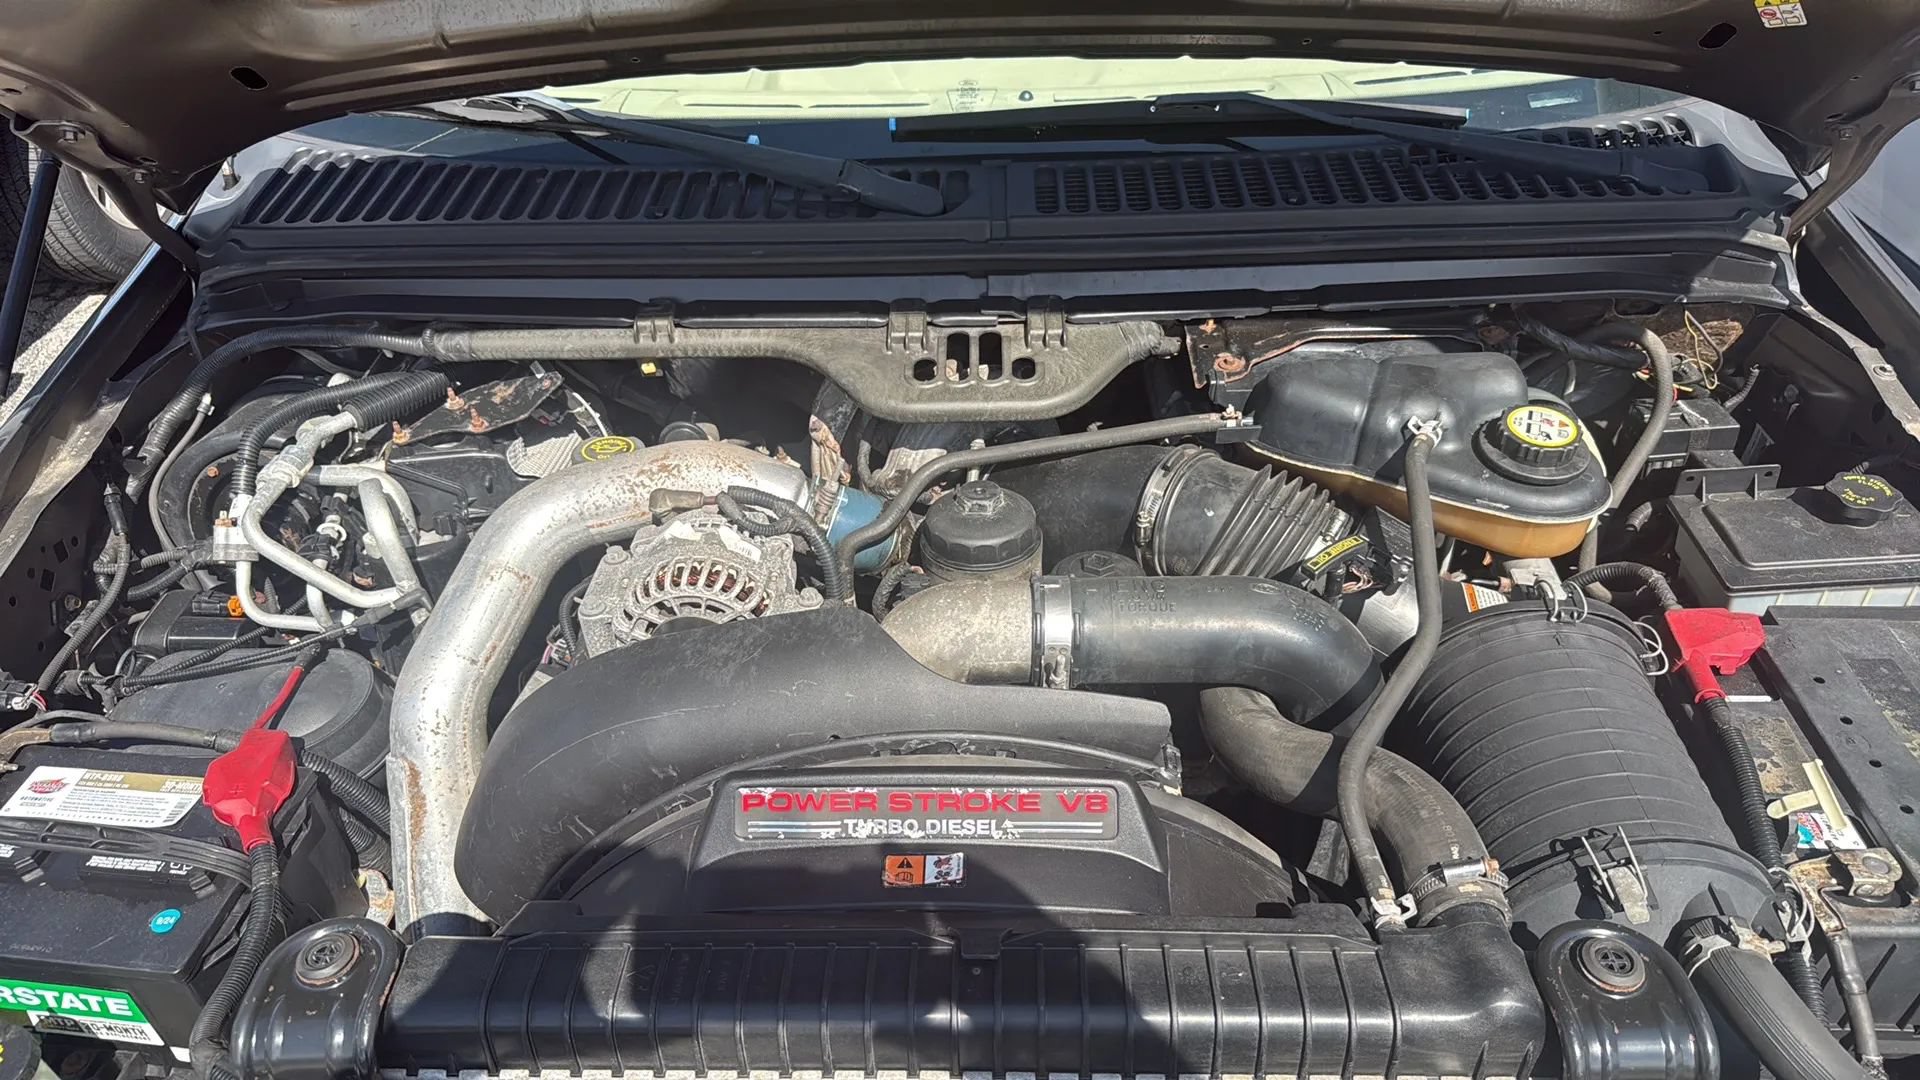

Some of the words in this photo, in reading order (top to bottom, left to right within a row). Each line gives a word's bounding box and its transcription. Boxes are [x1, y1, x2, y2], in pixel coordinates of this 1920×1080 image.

[1119, 600, 1177, 613] TORQUE
[742, 791, 878, 814] POWER
[887, 791, 1042, 814] STROKE
[1056, 791, 1109, 815] V8
[844, 818, 919, 836] TURBO
[925, 818, 1001, 836] DIESEL
[45, 1015, 76, 1027] MTP
